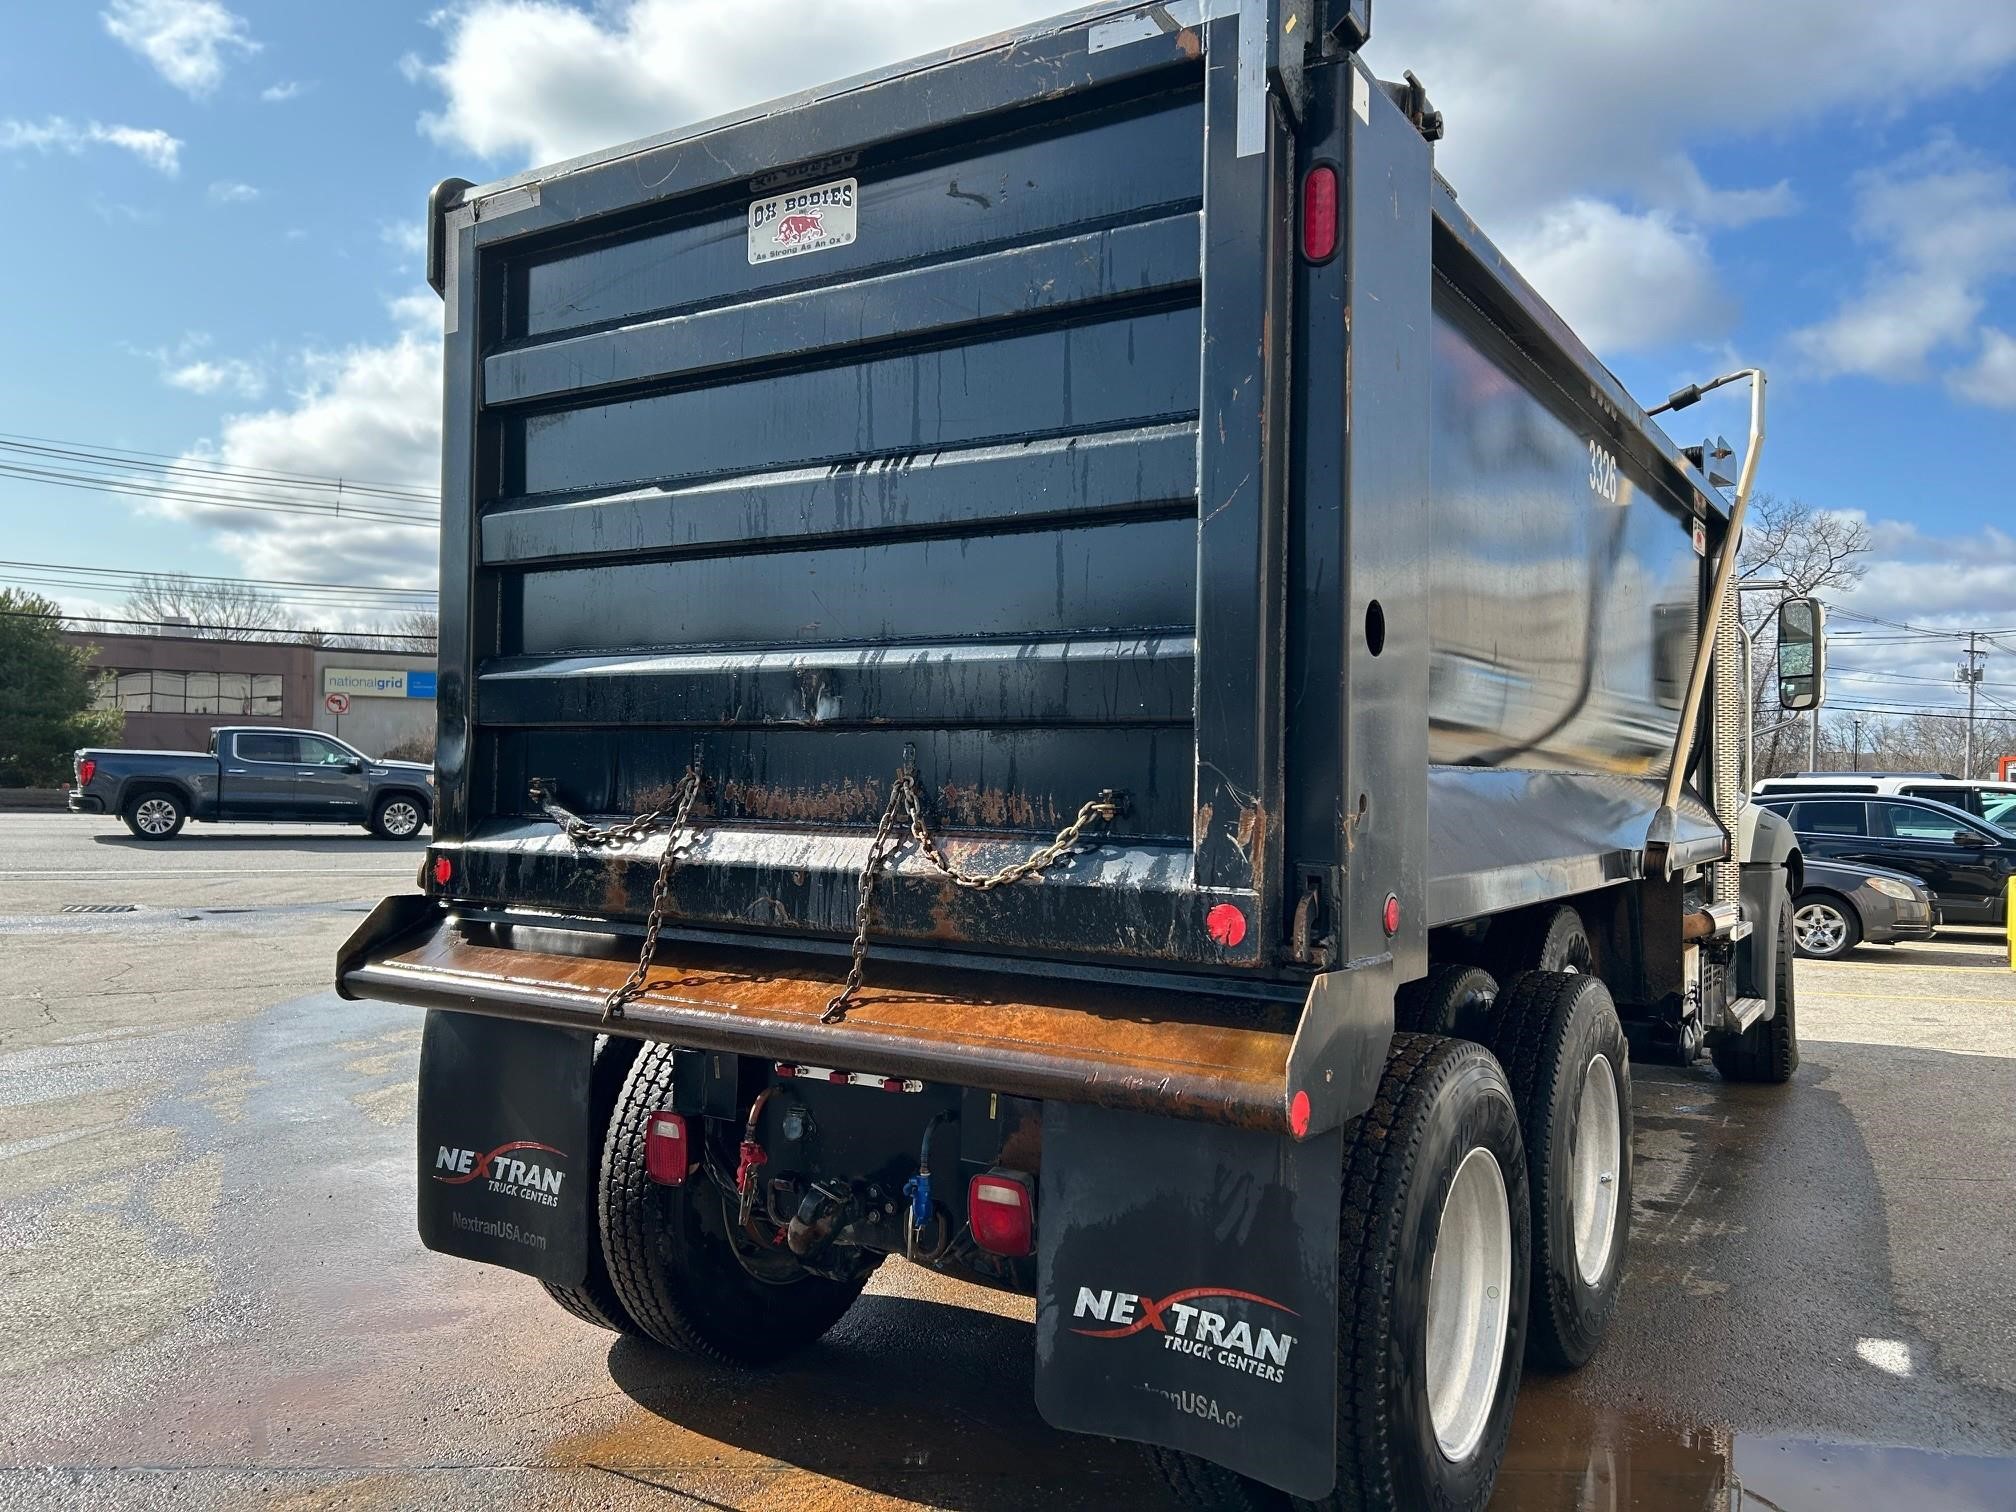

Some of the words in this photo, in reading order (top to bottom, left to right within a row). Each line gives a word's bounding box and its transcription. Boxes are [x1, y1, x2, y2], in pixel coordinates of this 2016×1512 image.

[753, 202, 777, 228] OX
[784, 184, 852, 212] BODIES
[801, 242, 812, 251] As
[815, 240, 826, 248] An
[1589, 439, 1617, 503] 3326
[329, 676, 403, 690] nationalgrid
[435, 1145, 562, 1195] NEXTRAN
[488, 1180, 518, 1197] TRUCK
[520, 1188, 559, 1208] CENTERS
[452, 1211, 547, 1250] NextranUSA.com
[1073, 1286, 1293, 1367] NEXTRAN
[1164, 1334, 1213, 1361] TRUCK
[1217, 1350, 1285, 1384] CENTERS
